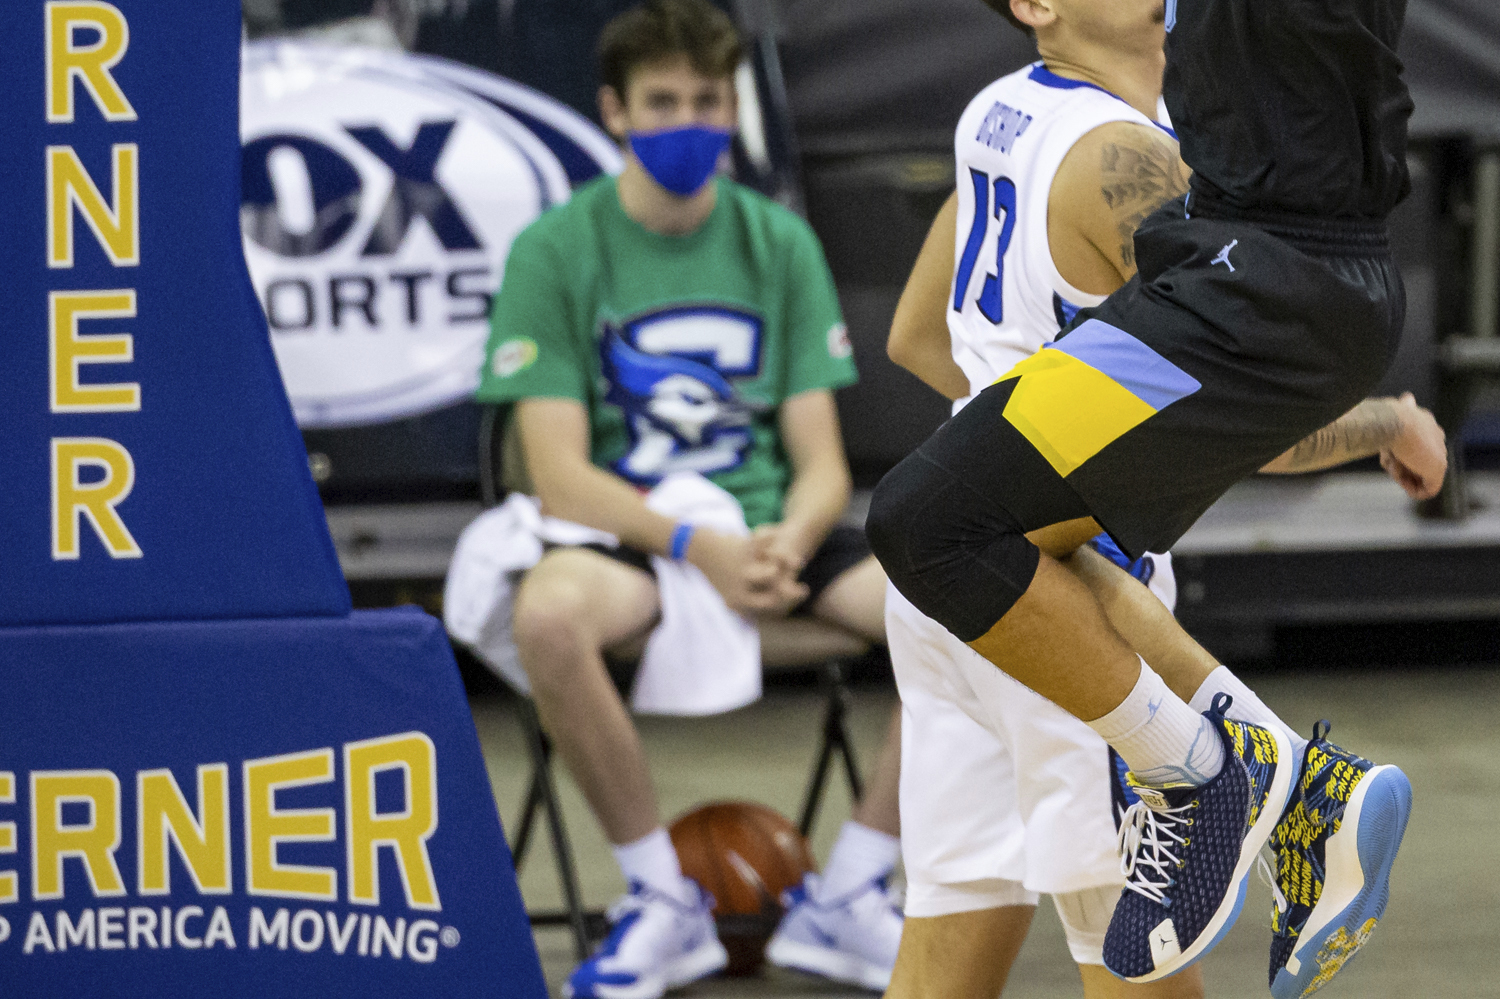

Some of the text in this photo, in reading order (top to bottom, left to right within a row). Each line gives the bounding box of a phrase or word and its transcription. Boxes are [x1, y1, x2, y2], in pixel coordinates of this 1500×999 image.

[265, 267, 495, 330] ORTS
[953, 166, 1016, 325] 13
[0, 731, 442, 911] RNER
[22, 906, 236, 955] AMERICA
